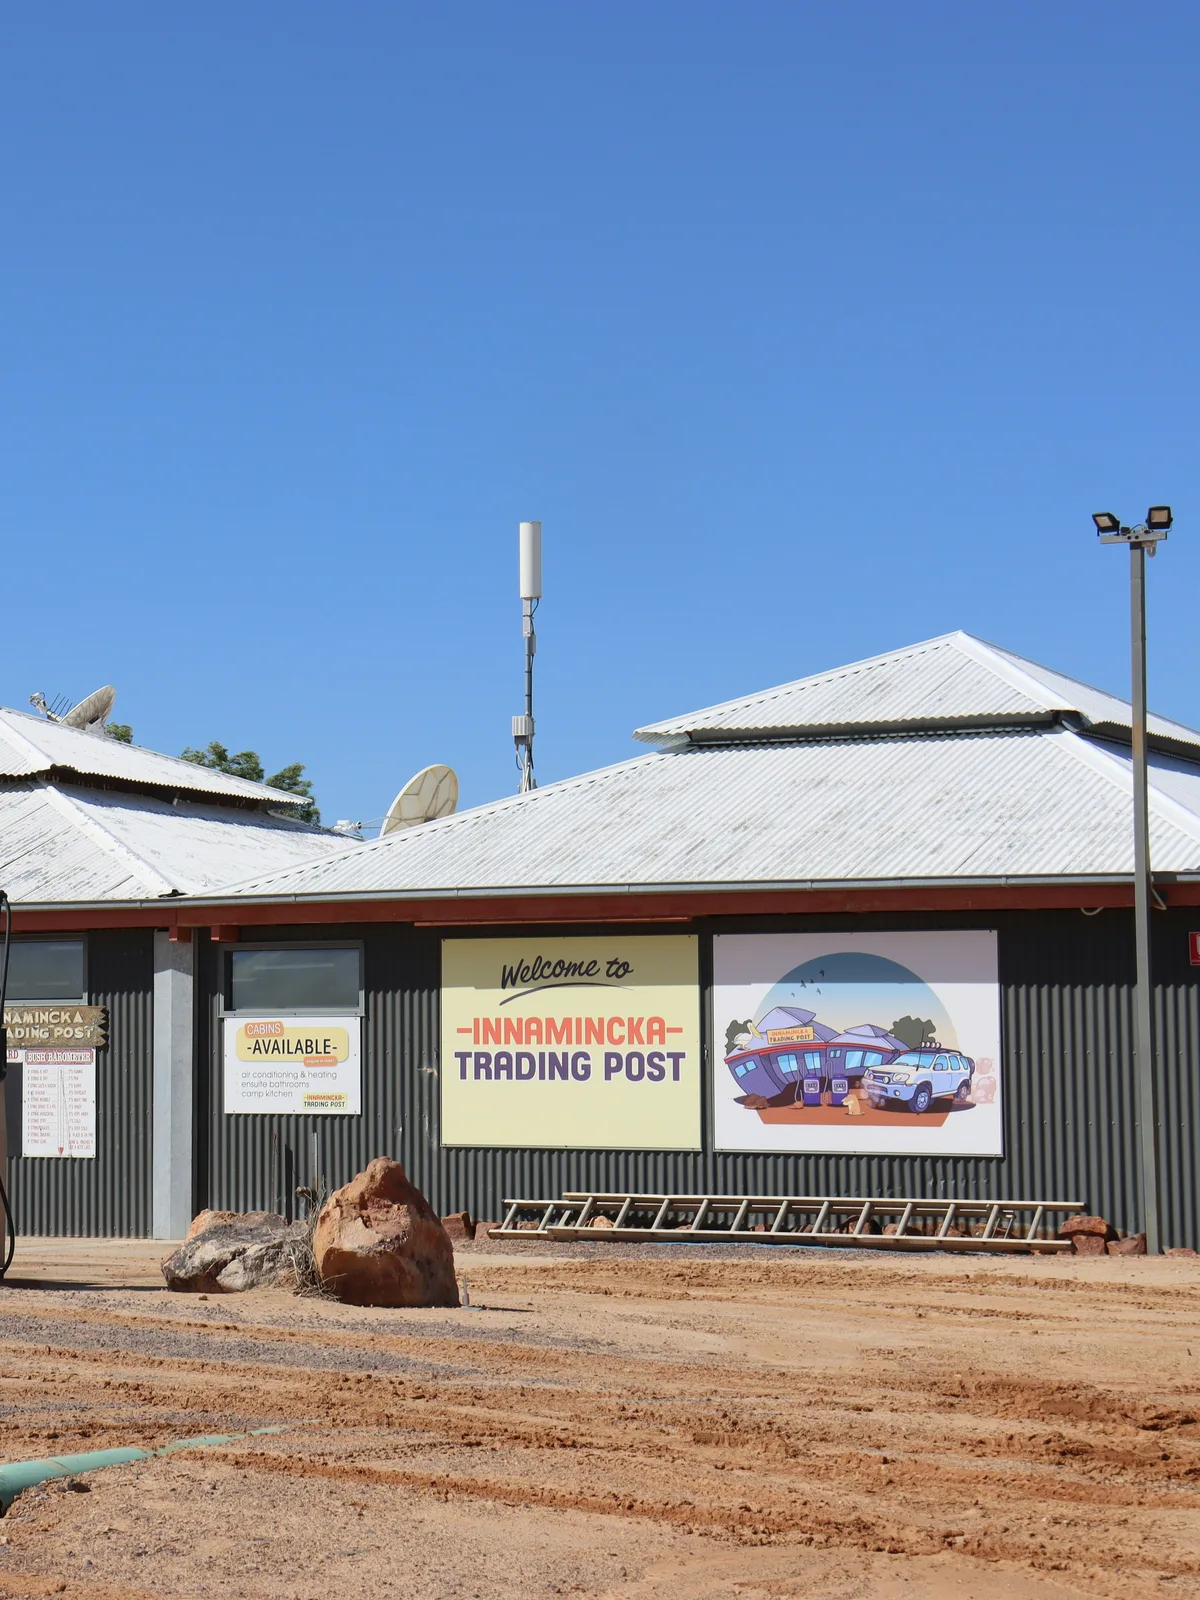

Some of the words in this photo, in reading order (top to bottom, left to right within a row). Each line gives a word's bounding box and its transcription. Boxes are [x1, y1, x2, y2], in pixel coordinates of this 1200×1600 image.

[501, 955, 601, 990] Welcome
[606, 957, 634, 979] to
[3, 1010, 84, 1024] NAMINCKA
[6, 1026, 50, 1039] ADING
[54, 1026, 94, 1039] POST
[247, 1023, 281, 1036] CABINS
[28, 1052, 46, 1062] BUSH
[48, 1052, 91, 1062] BAROMETER
[454, 1050, 592, 1082] TRADING
[604, 1050, 686, 1082] POST
[241, 1071, 251, 1079] air
[252, 1070, 299, 1080] conditioning
[300, 1071, 306, 1079] &
[307, 1070, 338, 1080] heating
[241, 1080, 268, 1088] ensuite
[269, 1080, 310, 1088] bathrooms
[241, 1090, 264, 1098] camp
[265, 1089, 293, 1097] kitchen
